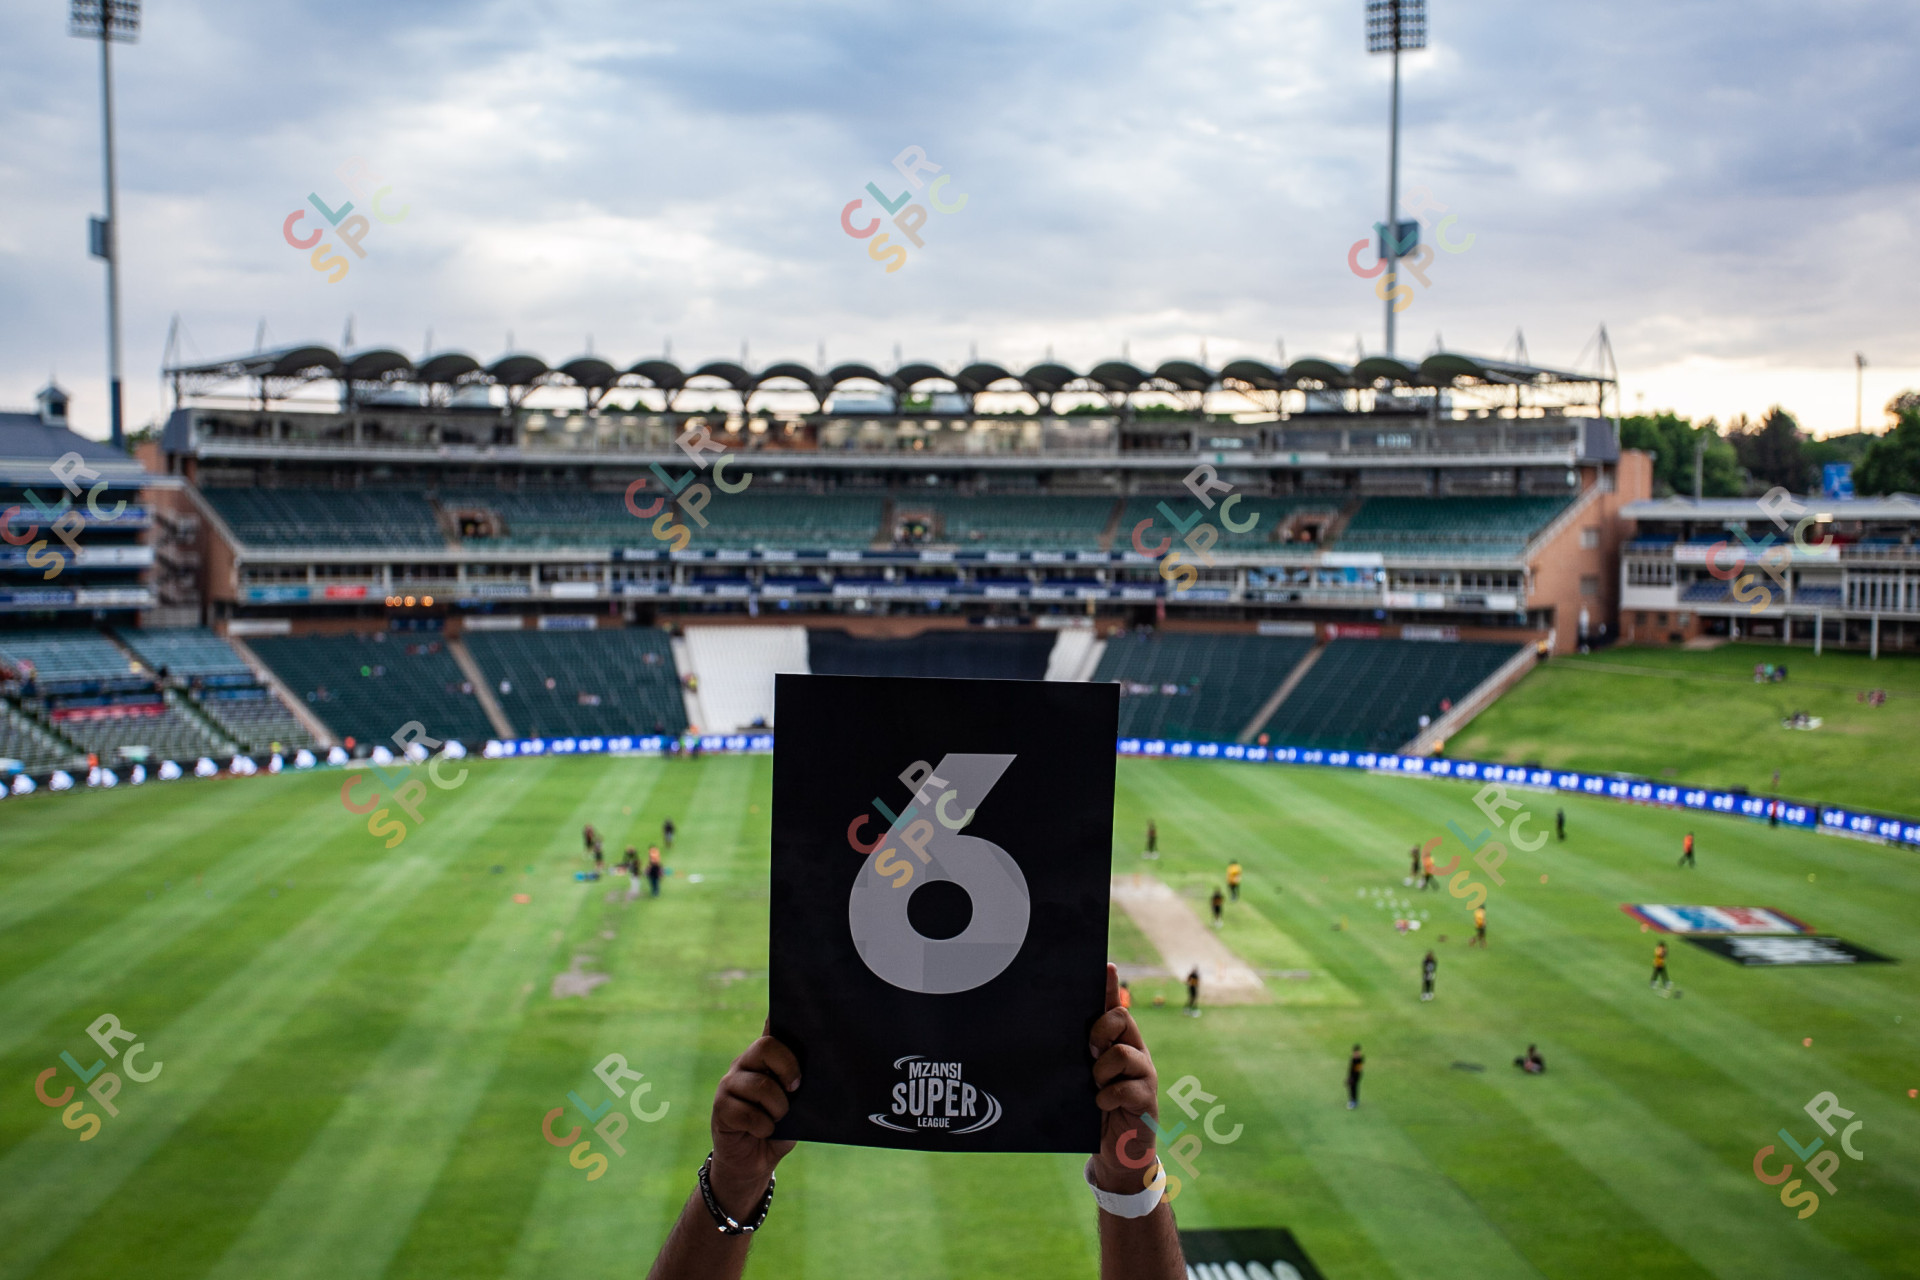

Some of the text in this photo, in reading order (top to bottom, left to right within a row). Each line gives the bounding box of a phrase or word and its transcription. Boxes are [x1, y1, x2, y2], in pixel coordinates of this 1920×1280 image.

[849, 753, 1030, 994] 6
[908, 1062, 962, 1080] MZANSI
[891, 1077, 978, 1117] SUPER
[917, 1117, 950, 1128] LEAGUE
